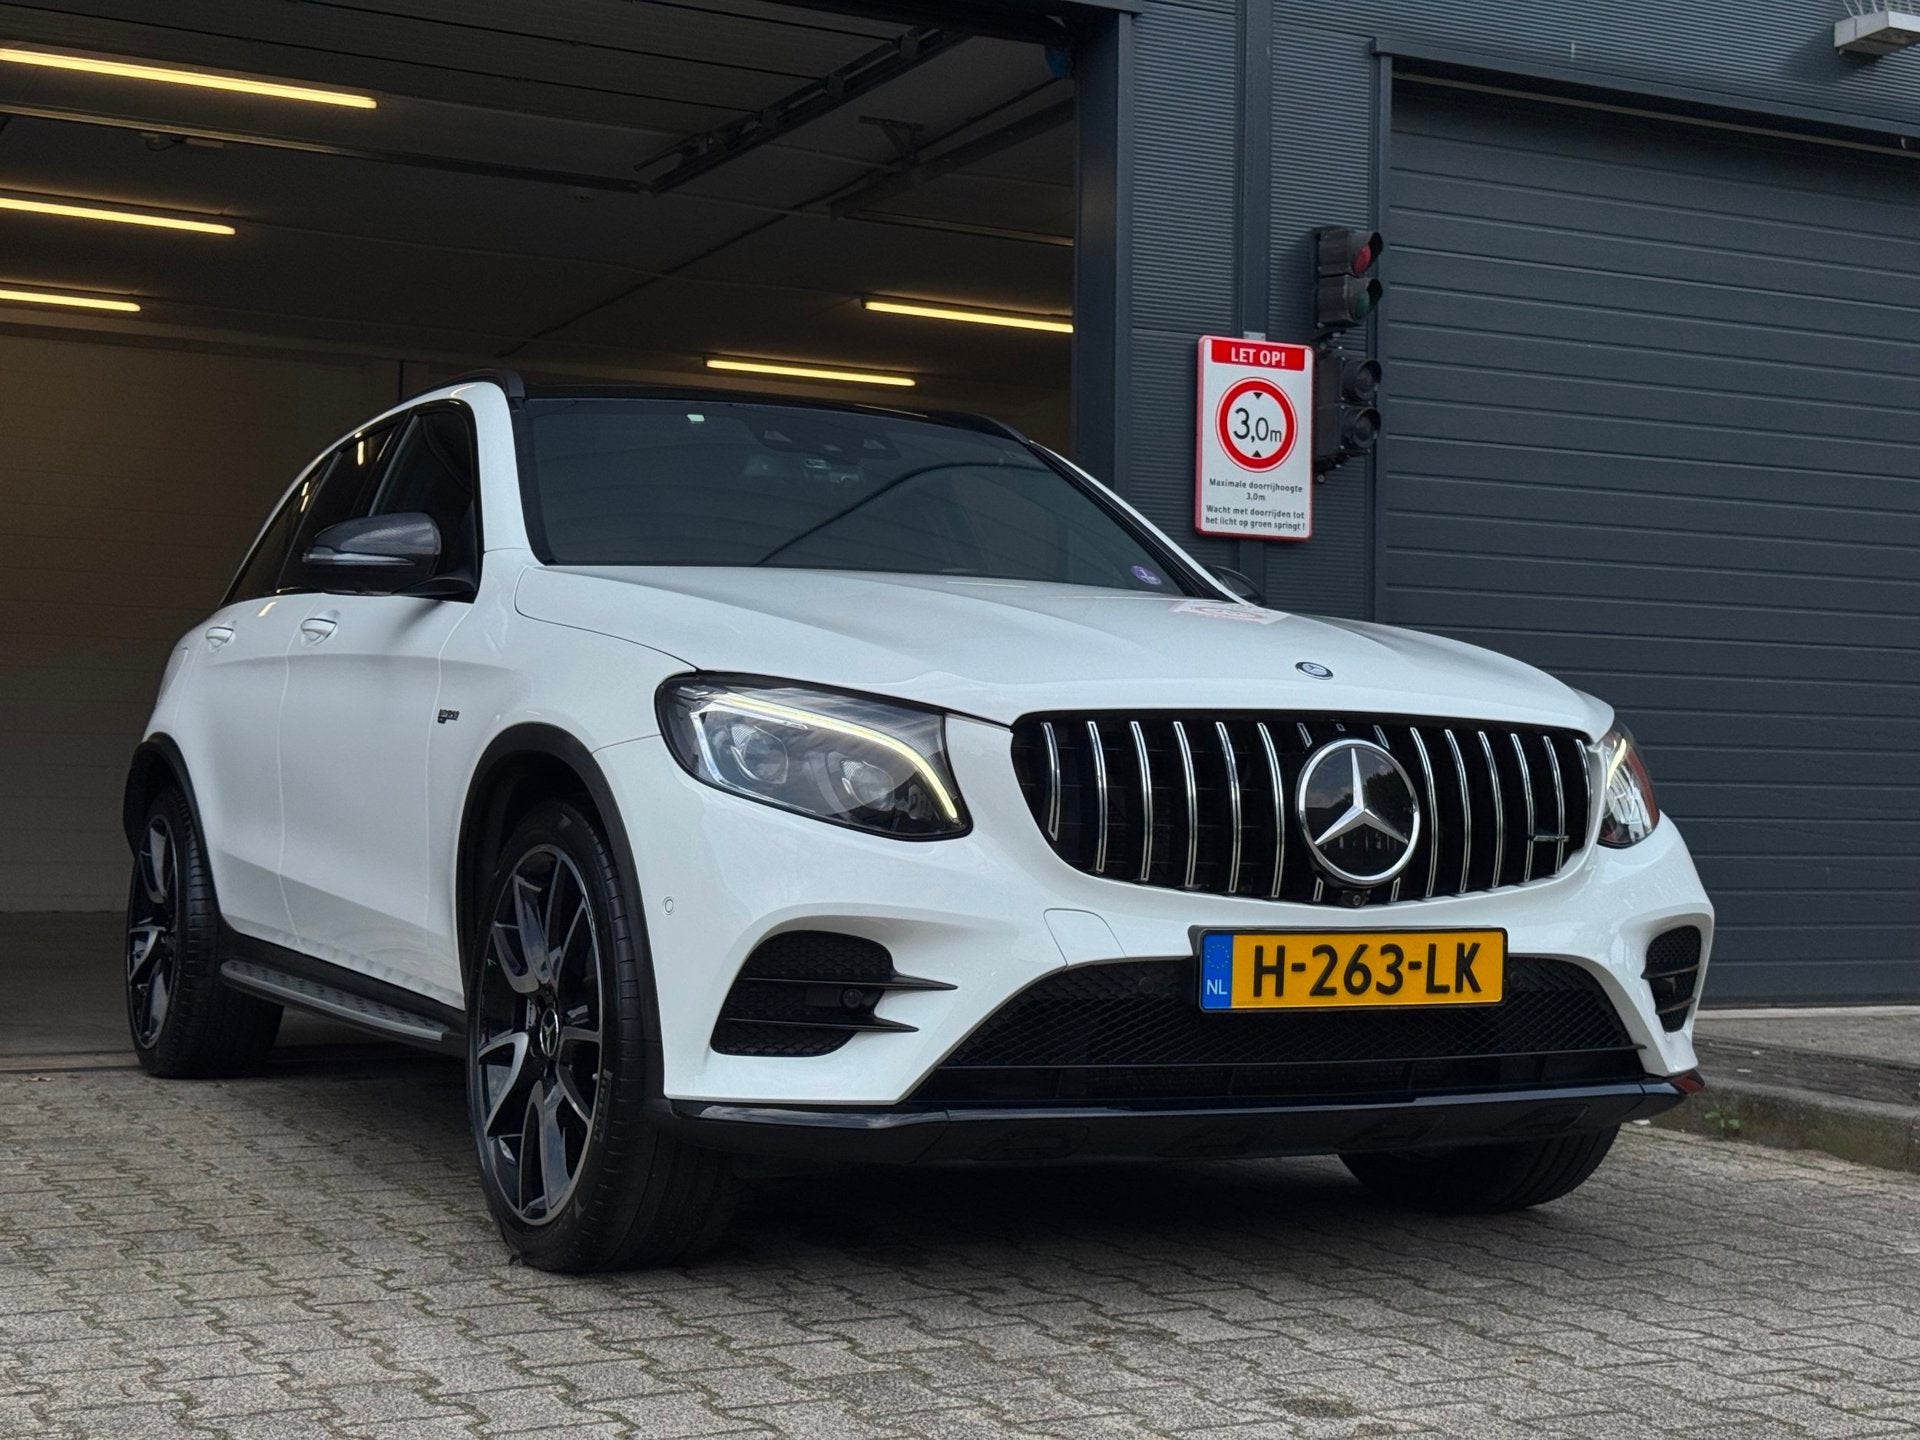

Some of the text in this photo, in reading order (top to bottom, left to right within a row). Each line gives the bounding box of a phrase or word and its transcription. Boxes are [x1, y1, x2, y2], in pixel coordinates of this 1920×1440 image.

[1231, 346, 1286, 367] LET OP!
[1233, 407, 1282, 443] 3,0m
[1209, 478, 1303, 494] Maximale doorrijhoogte
[1205, 505, 1231, 514] Wacht
[1233, 507, 1248, 516] met
[1250, 508, 1291, 519] doorrijden
[1205, 516, 1218, 524] het
[1219, 517, 1237, 526] licht
[1239, 520, 1249, 528] op
[1250, 521, 1272, 529] groen
[1274, 521, 1301, 532] springt
[1253, 942, 1482, 997] H-263-LK
[1206, 979, 1228, 995] NL
